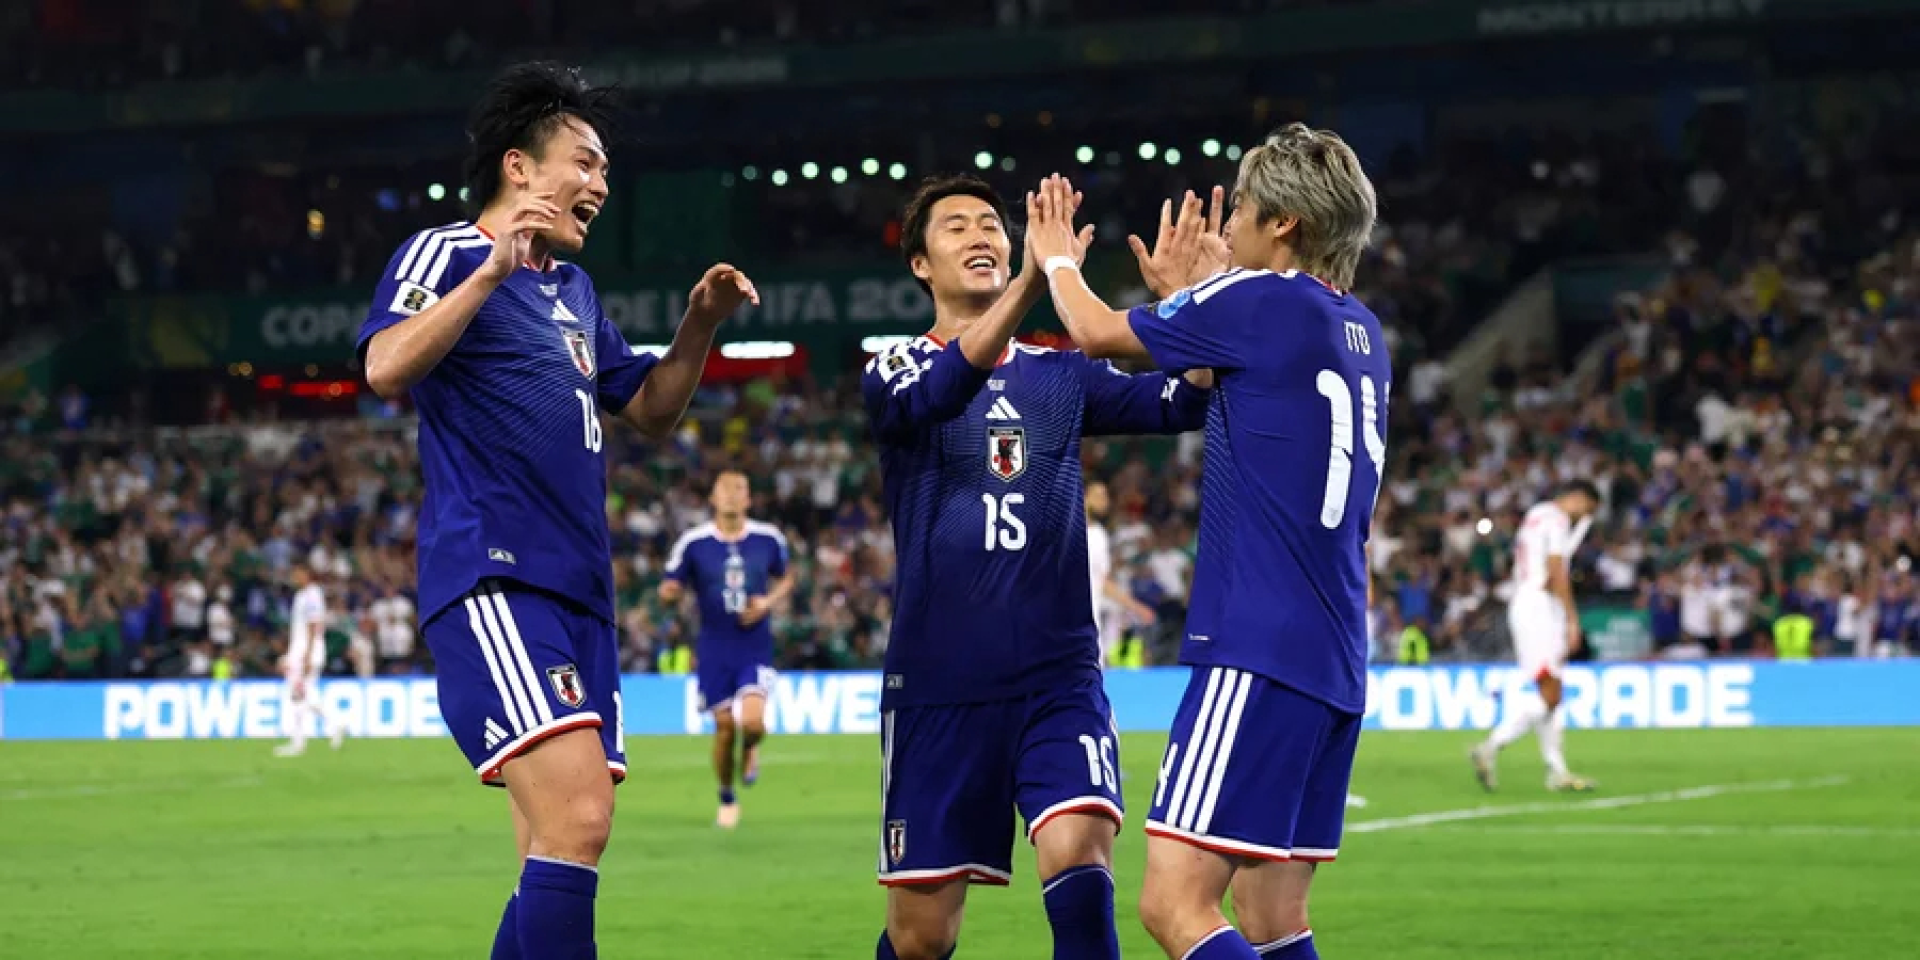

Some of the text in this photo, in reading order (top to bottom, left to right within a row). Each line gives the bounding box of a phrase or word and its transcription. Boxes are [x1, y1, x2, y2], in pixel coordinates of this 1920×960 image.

[847, 279, 933, 322] 20
[1344, 321, 1371, 355] ITO
[575, 388, 603, 454] 16
[1316, 368, 1390, 530] 14
[981, 492, 1028, 552] 15
[1078, 733, 1117, 795] 15
